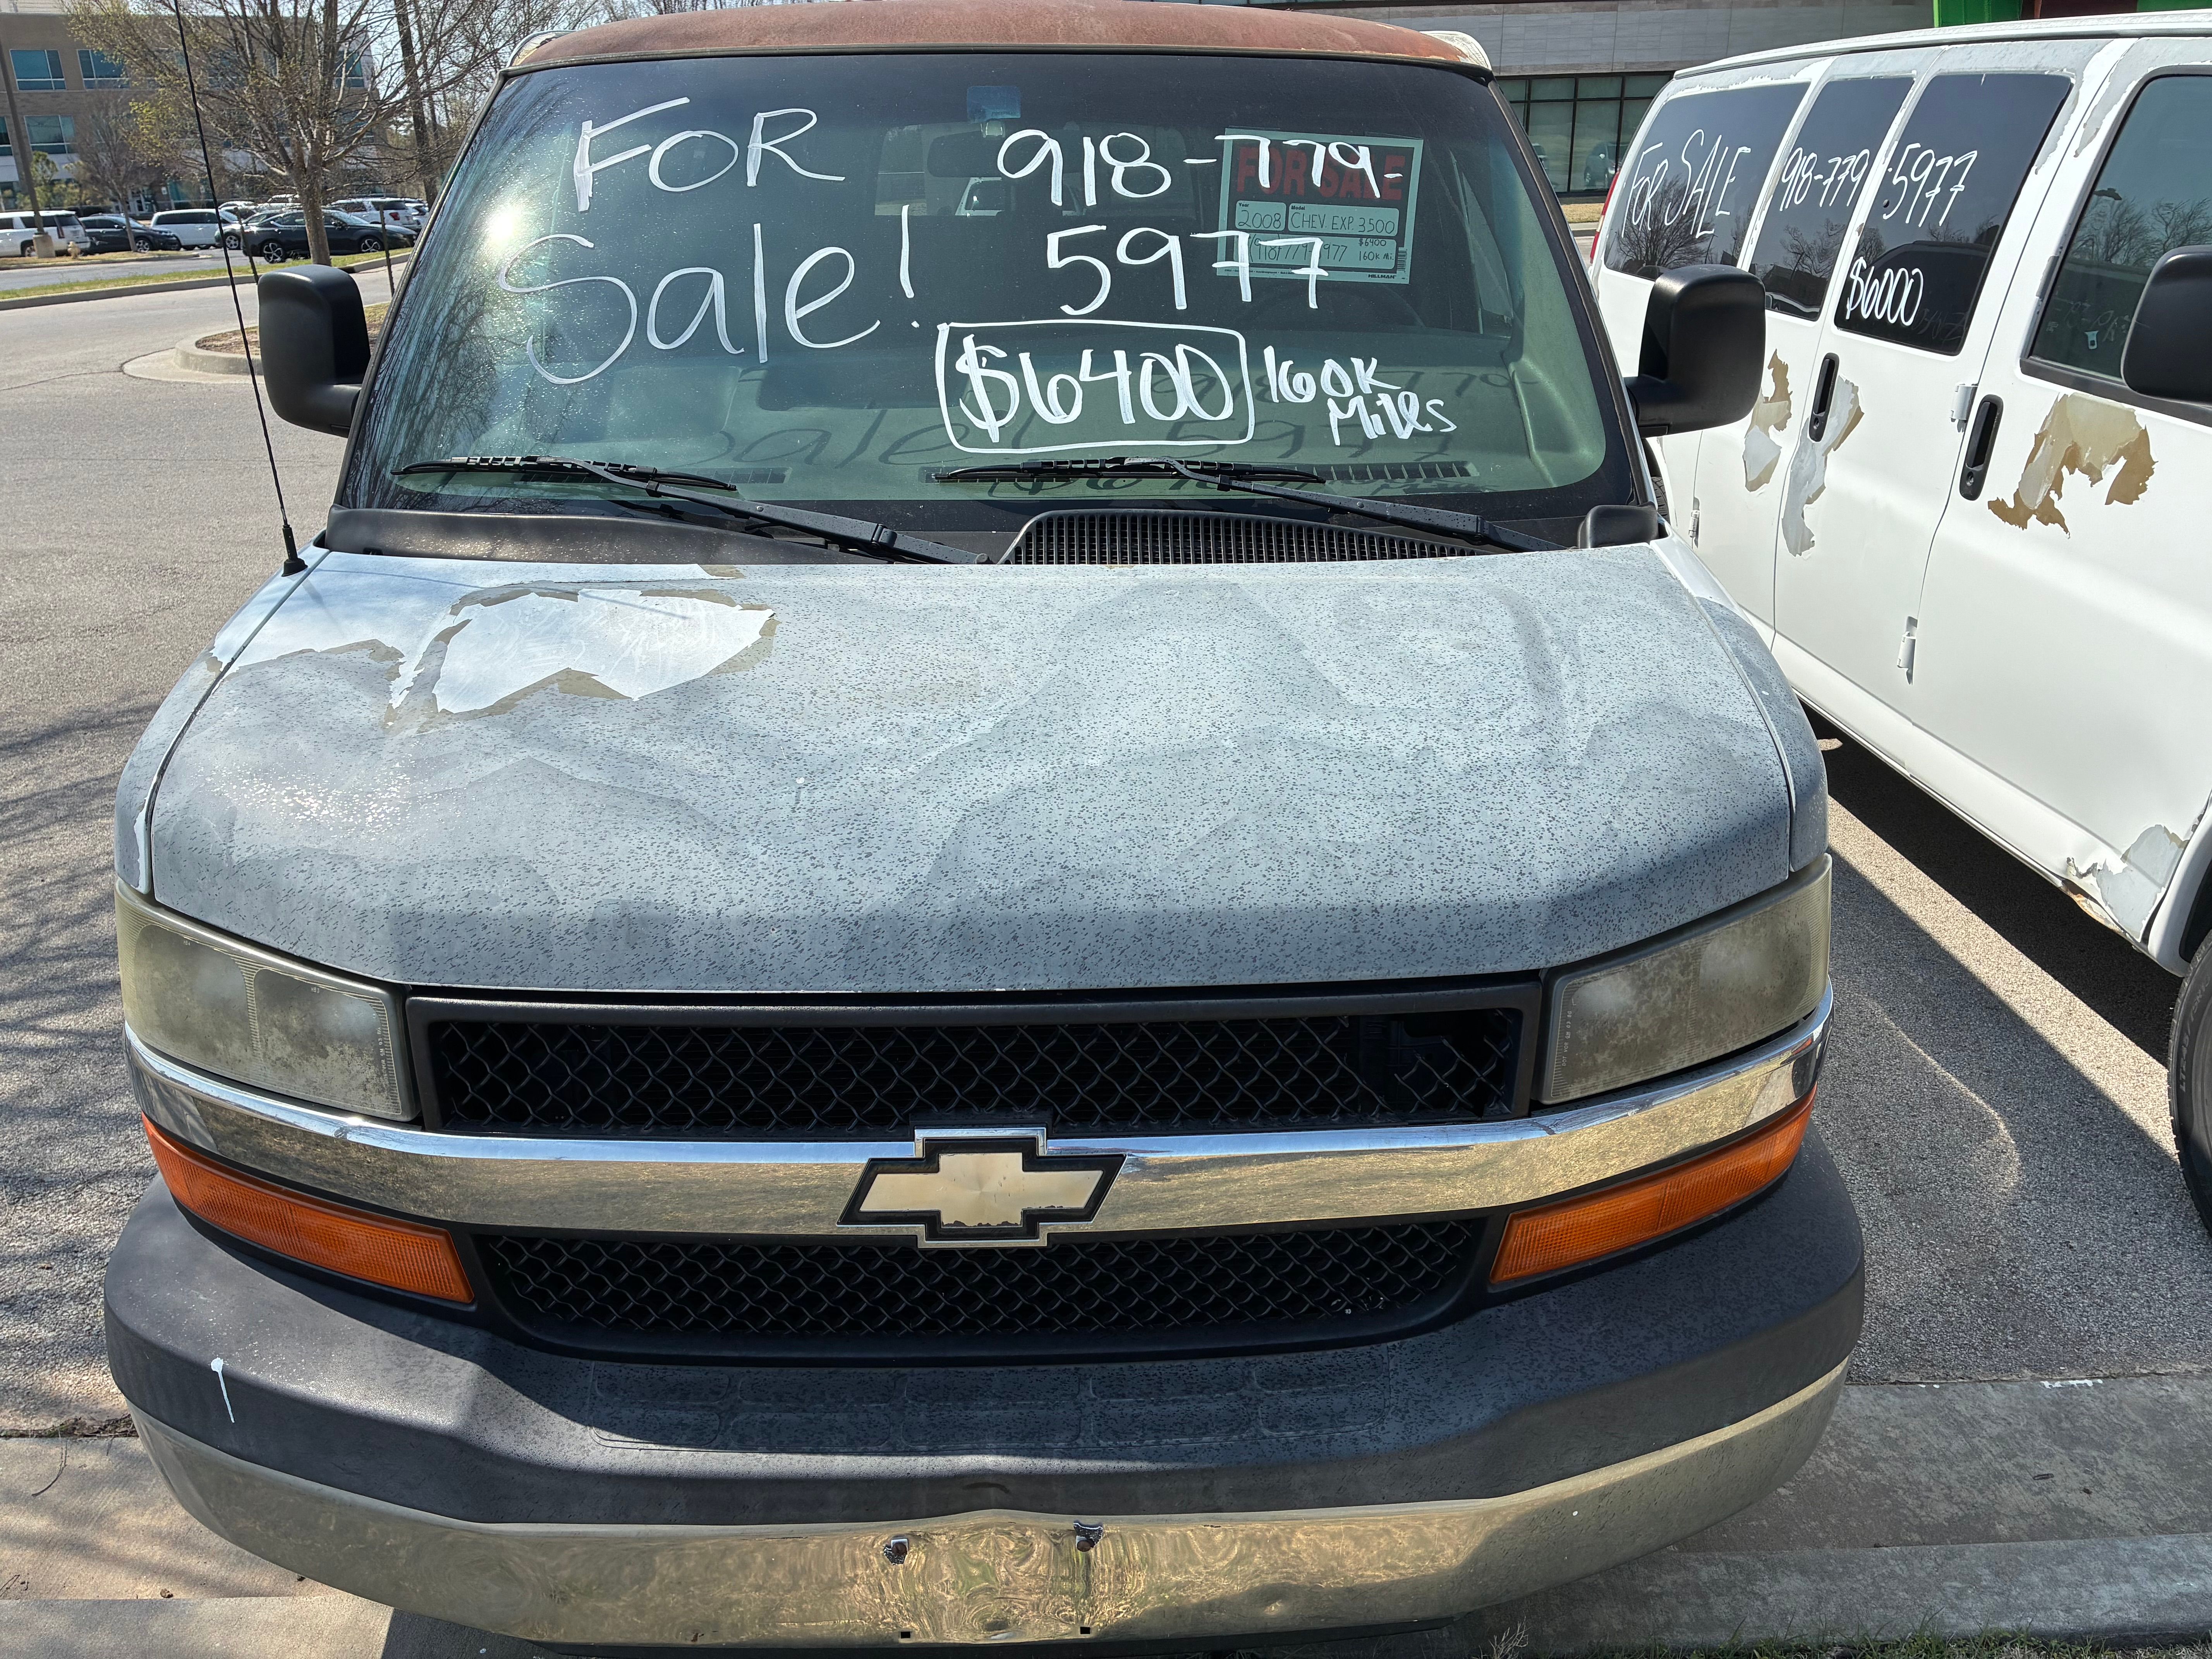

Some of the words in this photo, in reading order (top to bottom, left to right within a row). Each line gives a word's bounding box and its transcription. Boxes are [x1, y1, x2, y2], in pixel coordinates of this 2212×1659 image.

[574, 97, 845, 212] FOR
[1237, 146, 1307, 195] FOR
[1319, 150, 1405, 200] SALE
[1621, 142, 1668, 239] FOR
[1665, 129, 1751, 239] SALE
[1779, 148, 1870, 212] 918-779
[1238, 210, 1281, 228] 2008
[1291, 212, 1327, 229] CHEV.
[1332, 216, 1354, 231] EXP.
[1358, 218, 1395, 234] 3500
[1359, 238, 1386, 247] $6400
[498, 204, 920, 384] Sale!
[1047, 225, 1329, 315] 5977
[1846, 257, 1923, 327] $6000
[956, 334, 1233, 443] $6400
[1264, 345, 1401, 403] 160K
